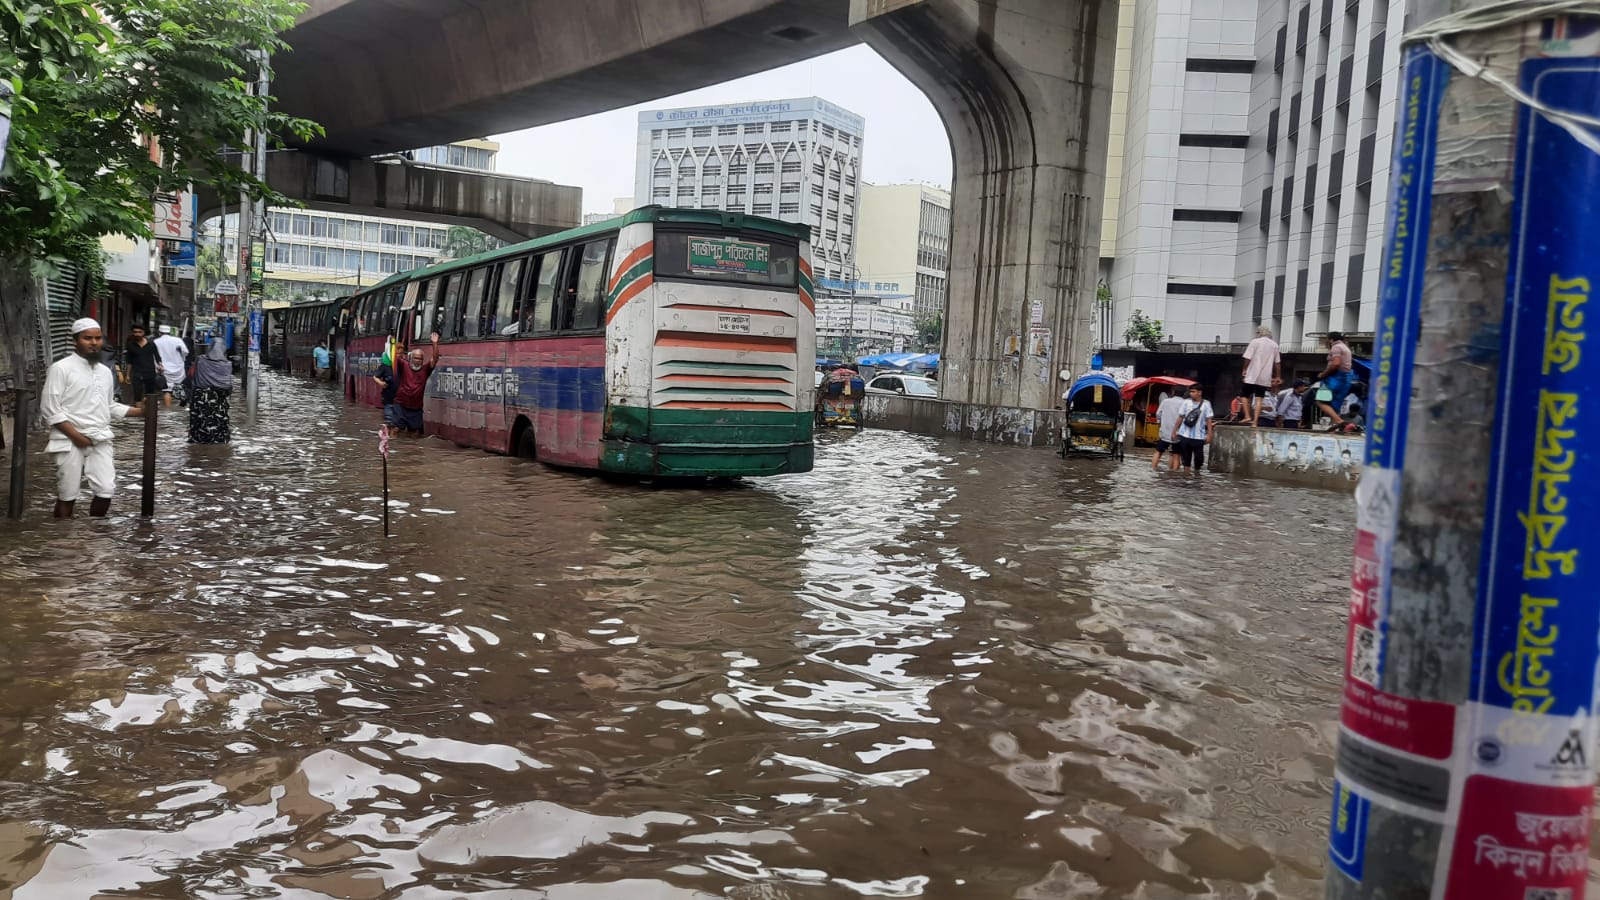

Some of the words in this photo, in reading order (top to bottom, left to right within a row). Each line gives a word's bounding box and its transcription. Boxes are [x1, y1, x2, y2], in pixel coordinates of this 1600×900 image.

[1402, 75, 1422, 151] Dhaka
[691, 241, 723, 260] গাজীপুর
[725, 244, 754, 262] পরিবহন
[1541, 273, 1590, 375] জন্য
[1516, 388, 1578, 579] দুর্বলদের
[1474, 833, 1545, 879] কিনুন
